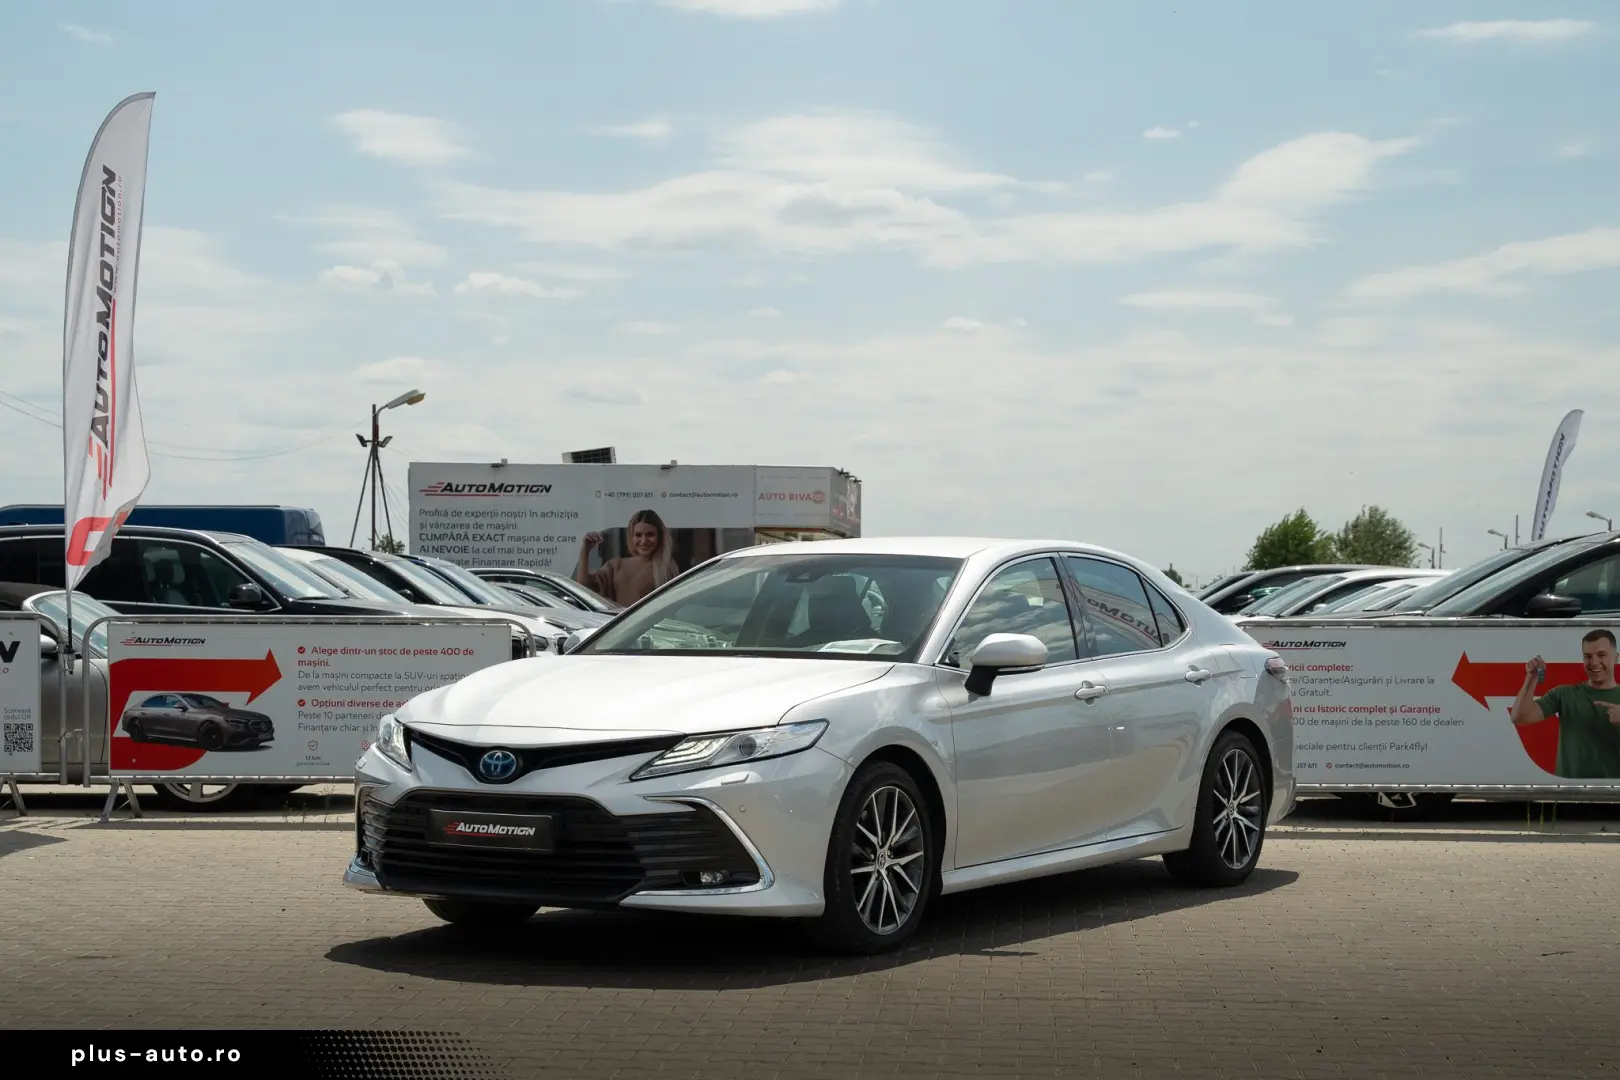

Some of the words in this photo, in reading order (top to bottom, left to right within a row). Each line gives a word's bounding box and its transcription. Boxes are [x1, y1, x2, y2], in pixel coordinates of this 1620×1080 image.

[91, 164, 116, 449] AUTOMOTION
[440, 482, 552, 494] AUTOMOTION
[758, 492, 786, 501] AUTO
[788, 492, 812, 502] RIVA
[419, 509, 449, 518] Profită
[451, 509, 463, 518] de
[464, 509, 499, 520] experții
[539, 509, 579, 520] achiziția
[419, 521, 428, 531] și
[428, 521, 471, 530] vânzarea
[472, 521, 485, 530] de
[419, 532, 470, 542] CUMPĂRĂ
[472, 533, 505, 542] EXACT
[507, 534, 541, 544] mașina
[543, 533, 555, 542] de
[556, 535, 577, 543] care
[419, 545, 430, 554] AI
[431, 545, 470, 554] NEVOIE
[471, 545, 481, 554] la
[482, 545, 495, 554] cel
[497, 545, 515, 554] mai
[516, 545, 535, 554] bun
[472, 558, 516, 569] Finanțare
[517, 558, 552, 569] Rapidă!
[134, 637, 206, 645] AUTOMOTION
[1272, 640, 1347, 648] AUTOMOTION
[311, 646, 338, 656] Alege
[340, 646, 377, 655] dintr-un
[378, 647, 398, 655] stoc
[399, 647, 411, 655] de
[413, 648, 438, 657] peste
[440, 648, 461, 656] 400
[462, 648, 474, 656] de
[297, 659, 331, 668] mașini.
[1306, 663, 1354, 673] complete:
[297, 671, 311, 679] De
[313, 671, 320, 679] la
[322, 671, 349, 681] mașini
[350, 671, 393, 681] compacte
[394, 671, 402, 679] la
[404, 671, 438, 680] SUV-uri
[1288, 676, 1384, 687] re/Garanție/Asigurări
[1385, 677, 1393, 687] și
[1394, 676, 1425, 685] Livrare
[1427, 676, 1435, 685] la
[322, 683, 359, 691] vehiculul
[361, 683, 392, 693] perfect
[394, 684, 422, 693] pentru
[1298, 688, 1333, 697] Gratuit.
[311, 699, 345, 709] Opțiuni
[347, 699, 381, 707] diverse
[382, 699, 394, 707] de
[1317, 705, 1347, 713] Istoric
[1348, 705, 1388, 715] complet
[1389, 705, 1398, 715] și
[1399, 705, 1441, 715] Garanție
[298, 711, 322, 719] Peste
[323, 711, 332, 719] 10
[335, 711, 374, 721] parteneri
[1307, 718, 1319, 726] de
[1321, 718, 1349, 728] mașini
[1351, 718, 1363, 726] de
[1365, 718, 1373, 726] la
[1374, 719, 1400, 727] peste
[1402, 718, 1417, 726] 160
[1419, 718, 1432, 726] de
[1433, 718, 1465, 726] dealeri
[298, 723, 338, 734] Finanțare
[339, 723, 360, 732] chiar
[362, 723, 369, 733] și
[1326, 743, 1356, 753] pentru
[1358, 742, 1387, 753] clienții
[1389, 742, 1428, 752] Park4fly!
[1334, 762, 1410, 770] contact@automotion.ro
[456, 822, 535, 836] AUTOMOTION
